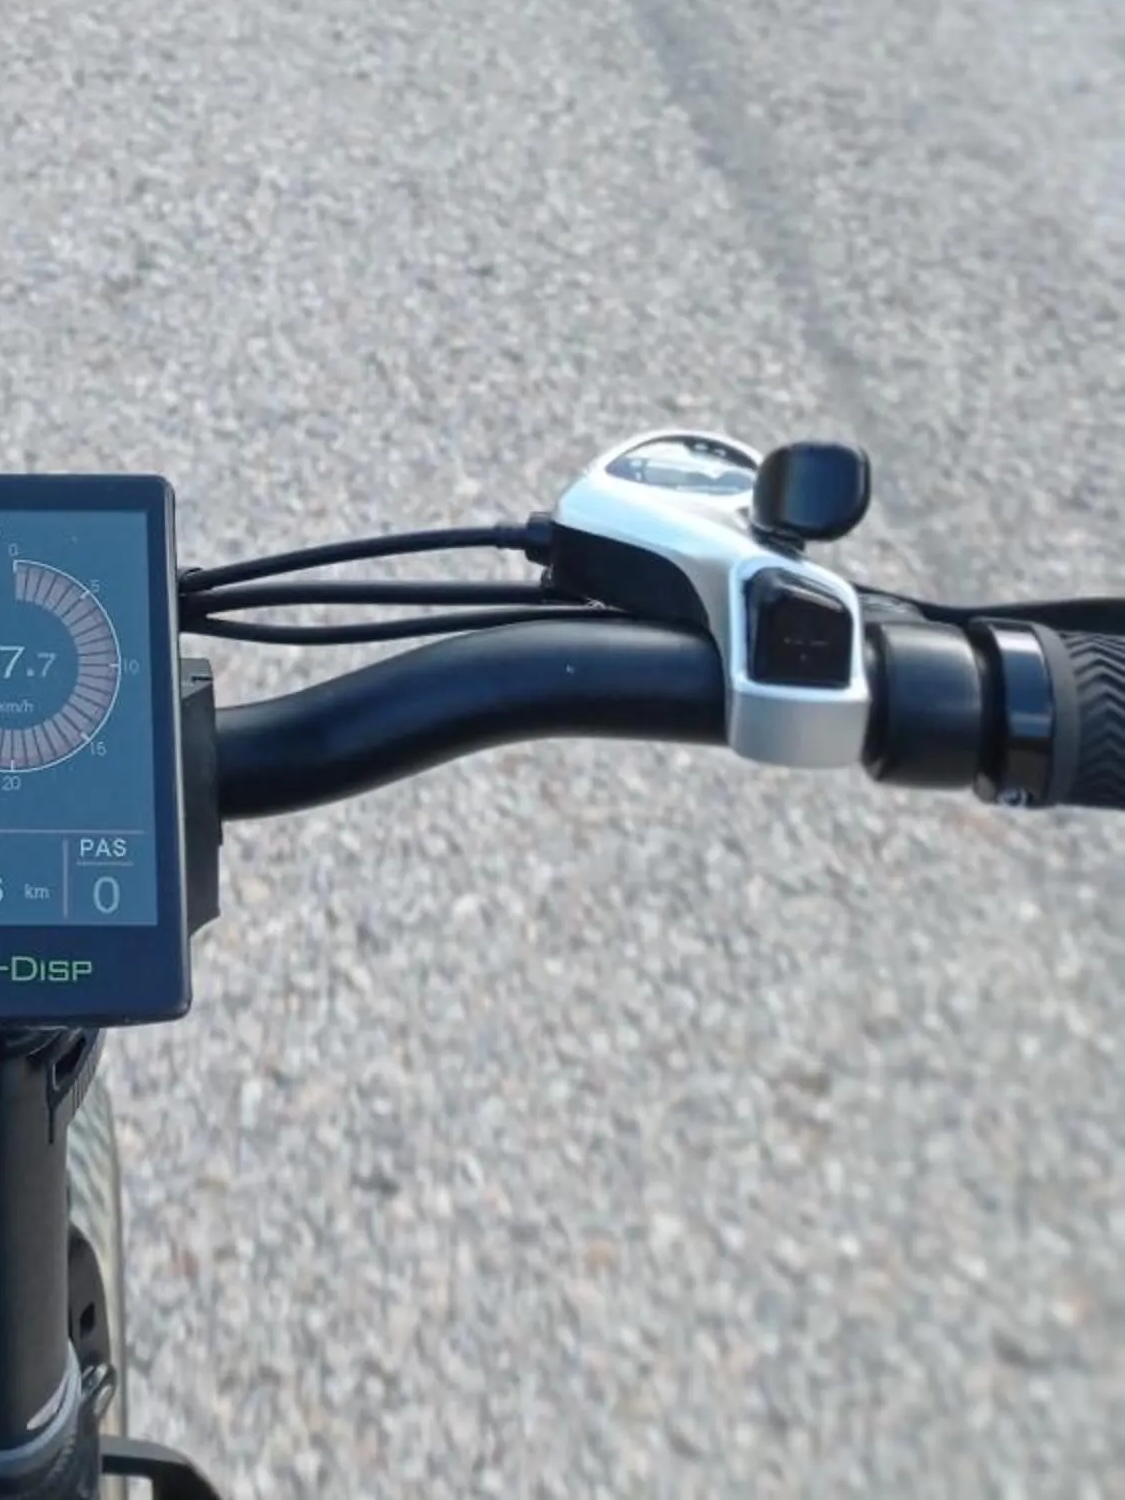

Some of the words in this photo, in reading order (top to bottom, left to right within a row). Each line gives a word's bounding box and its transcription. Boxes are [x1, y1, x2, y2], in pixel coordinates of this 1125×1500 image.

[80, 838, 127, 858] PAS
[24, 884, 50, 899] km
[93, 876, 120, 914] 0
